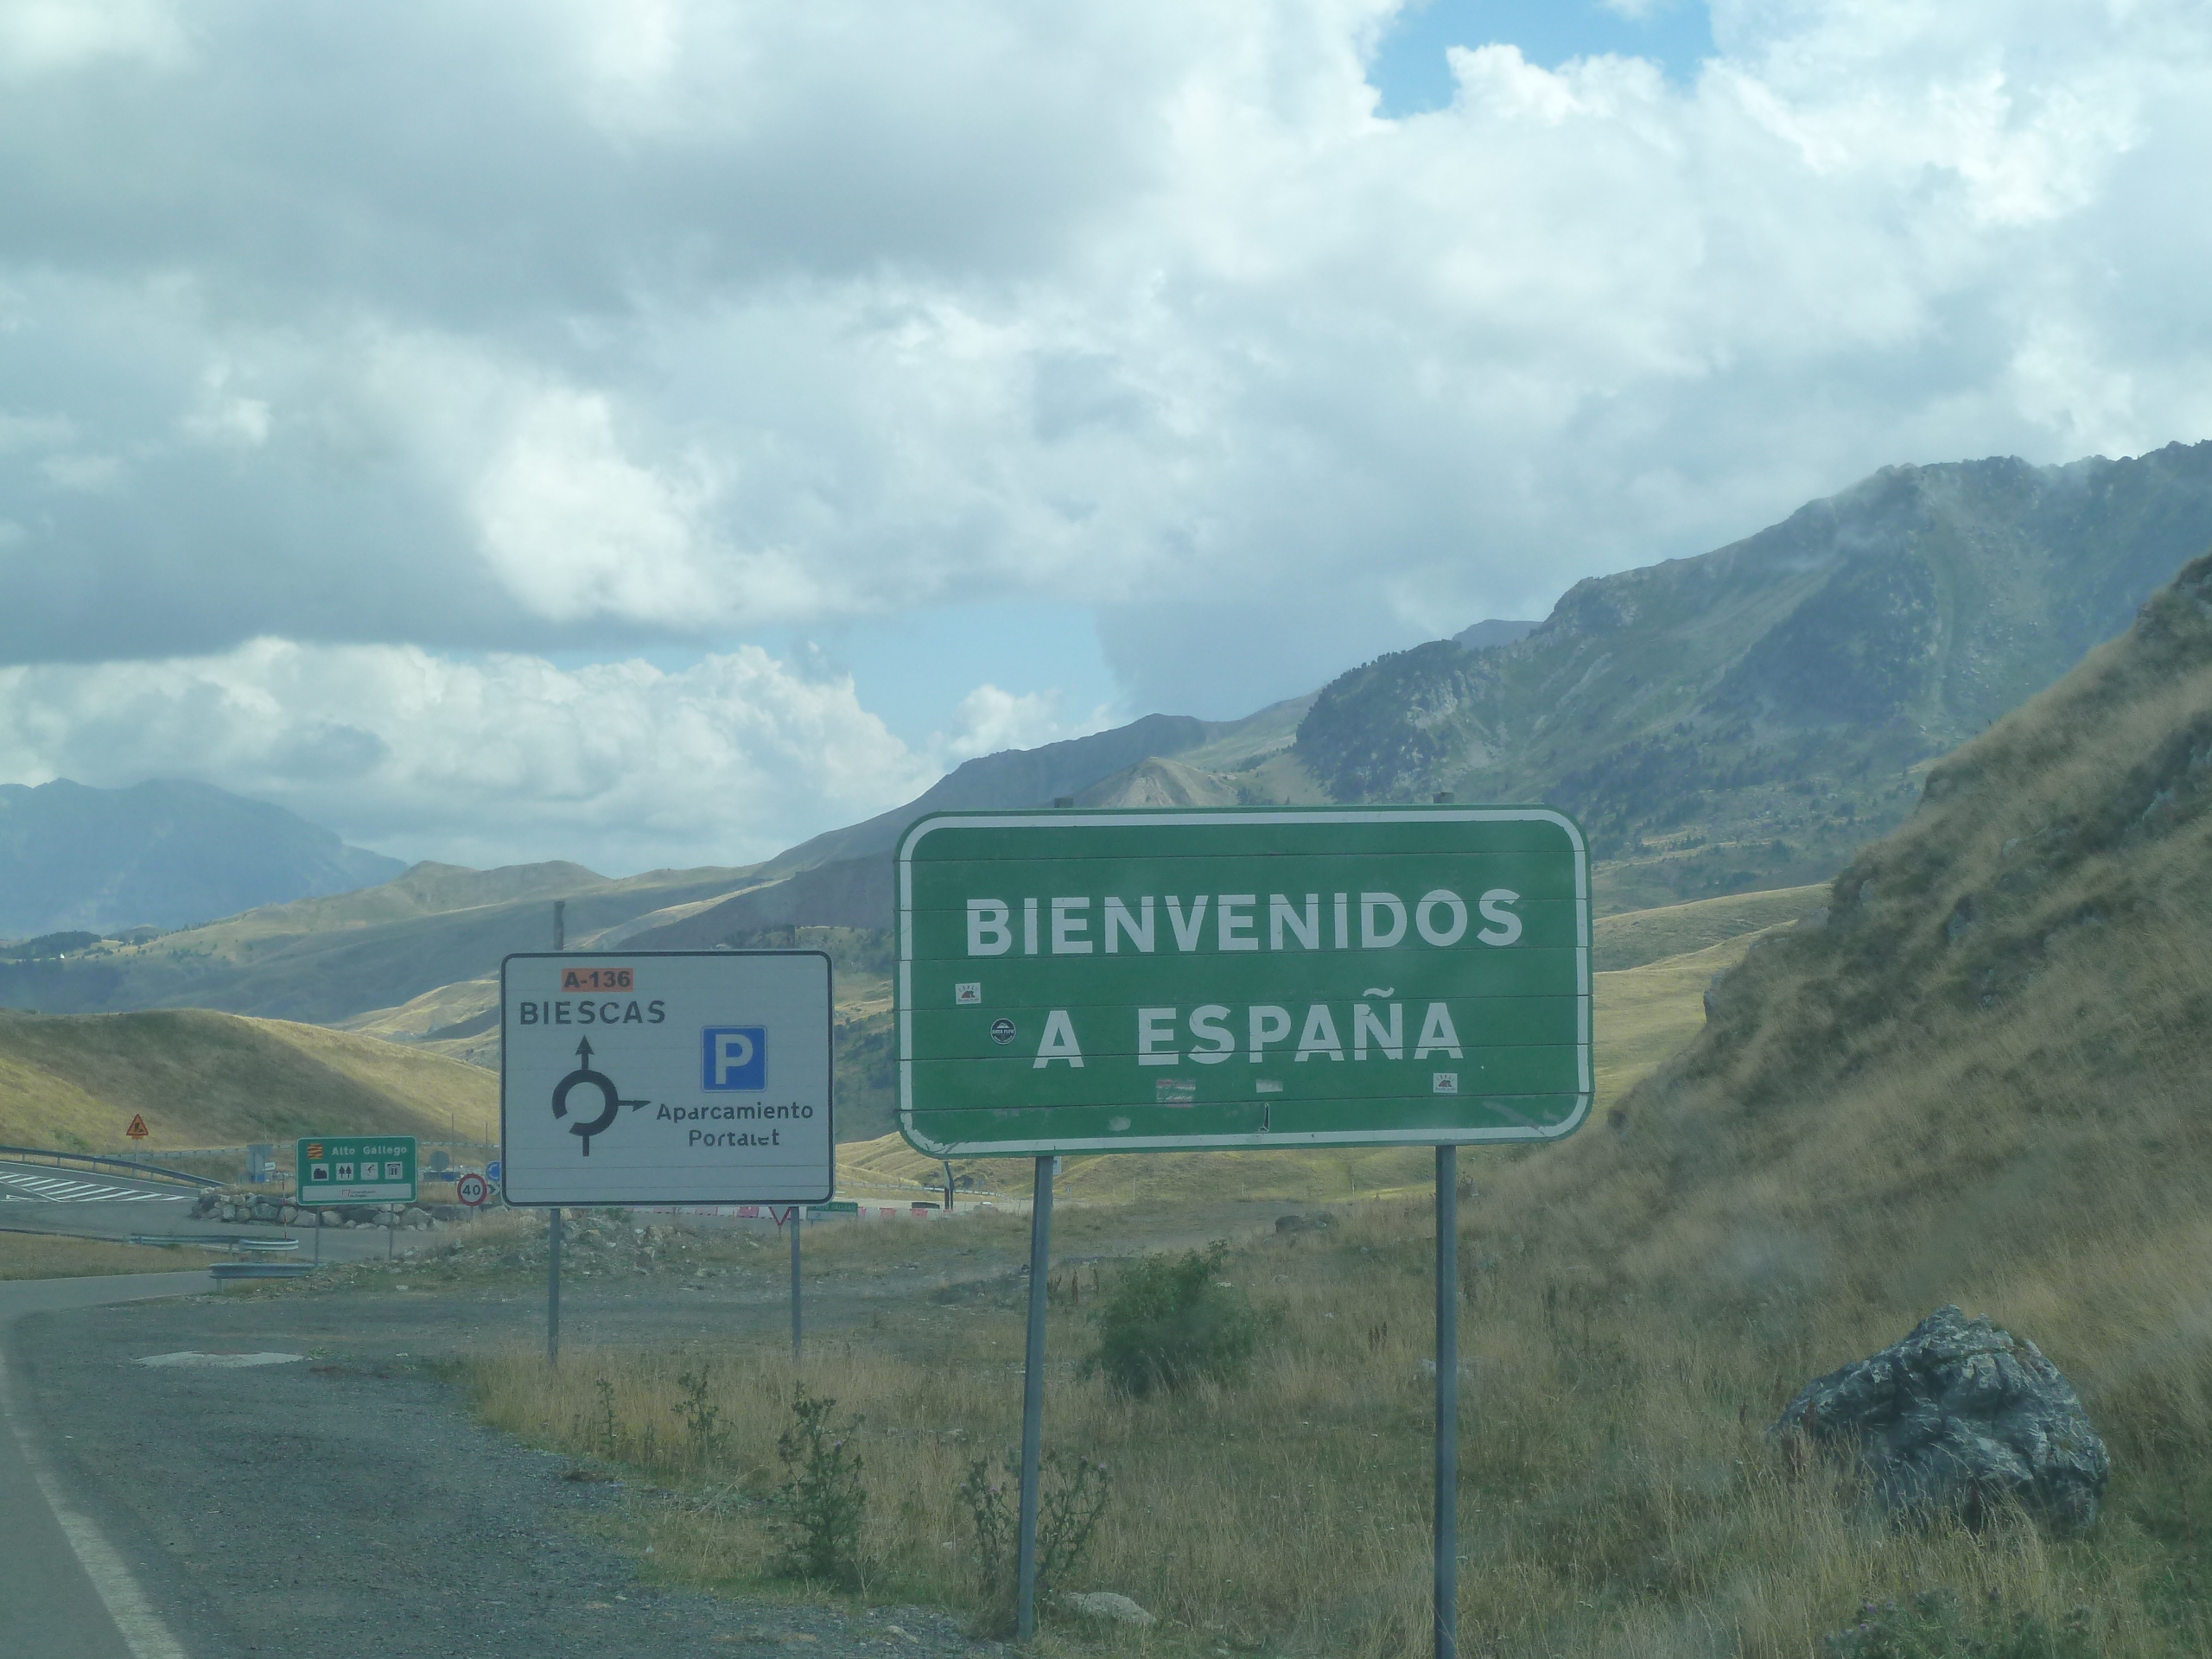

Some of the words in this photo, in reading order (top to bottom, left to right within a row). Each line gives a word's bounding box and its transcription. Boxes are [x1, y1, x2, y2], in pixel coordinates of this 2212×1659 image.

[966, 888, 1523, 957] BIENVENIDOS
[563, 970, 632, 988] A-136
[519, 1000, 666, 1025] BIESCAS
[1033, 1009, 1085, 1069] A
[1137, 987, 1465, 1065] ESPAÑA
[715, 1033, 754, 1085] P
[656, 1102, 814, 1124] Aparcamiento
[331, 1146, 356, 1156] Alto
[462, 1184, 481, 1196] 40
